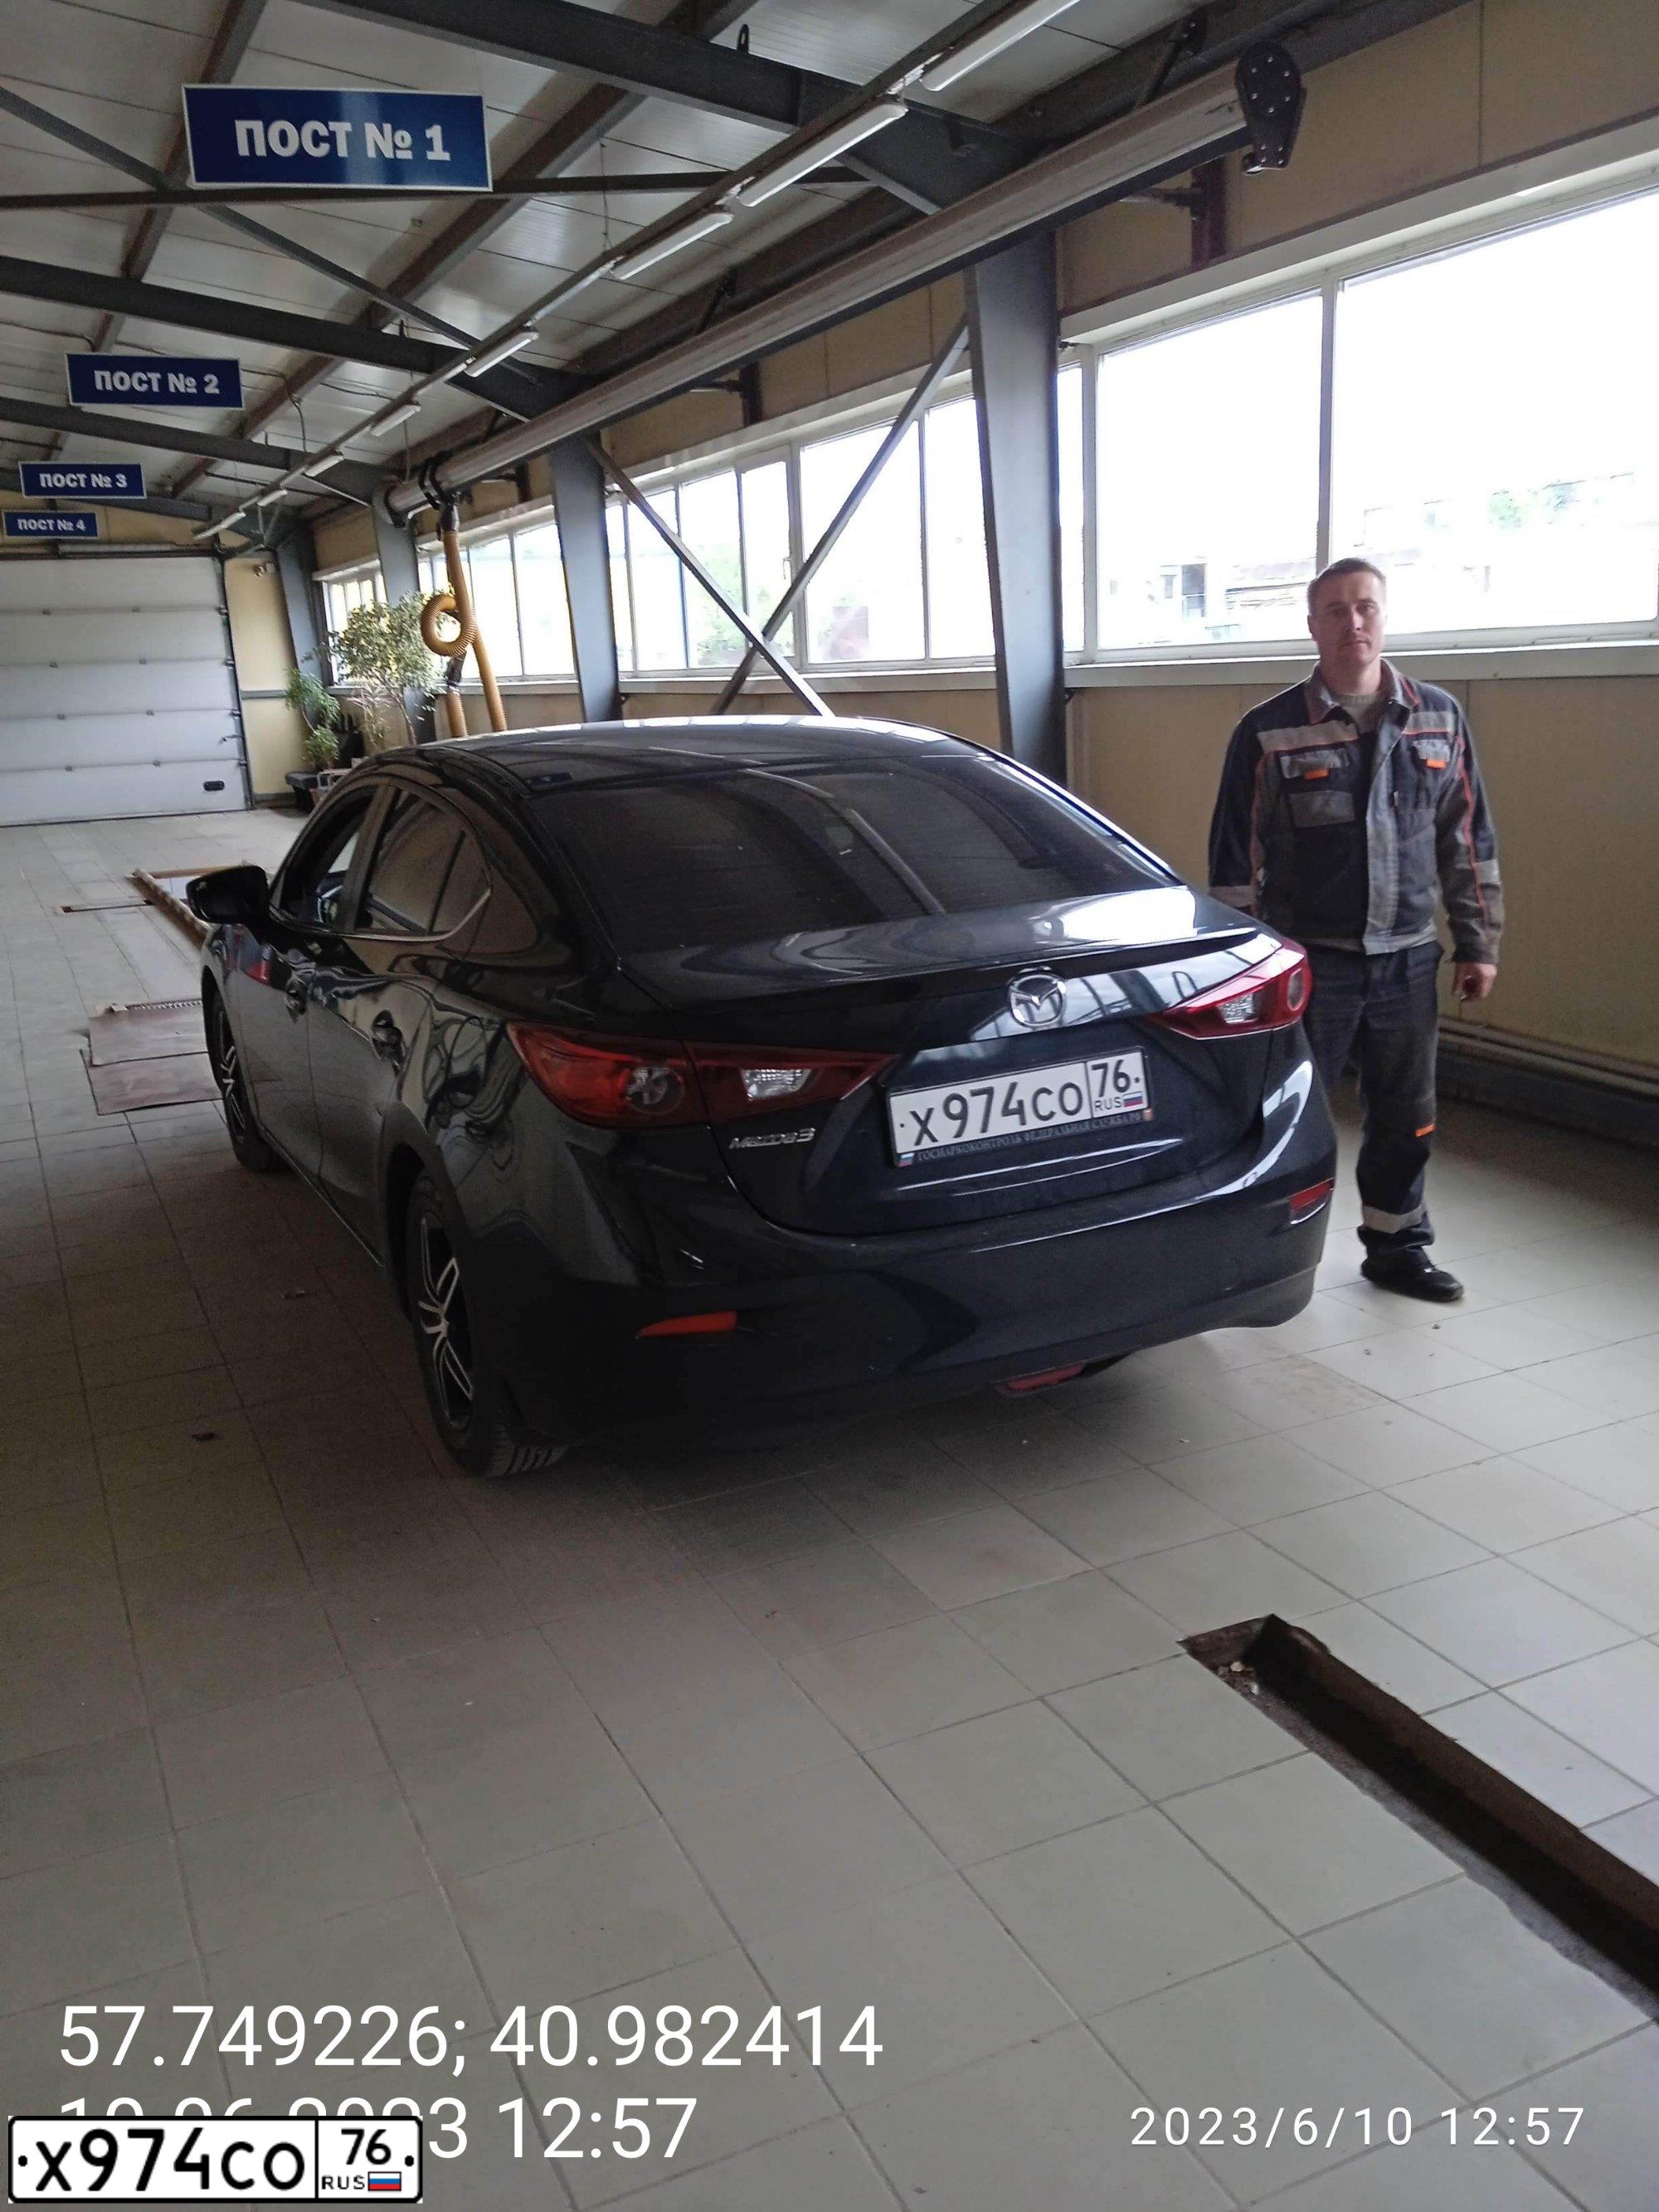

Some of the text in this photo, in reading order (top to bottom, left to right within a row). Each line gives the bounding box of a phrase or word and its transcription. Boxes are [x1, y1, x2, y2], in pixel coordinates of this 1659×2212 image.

[235, 120, 450, 161] ПОСТ № 1
[94, 370, 220, 394] ПОСТ № 2
[39, 473, 128, 488] ПОСТ № 3
[17, 518, 86, 532] ПОСТ № 4
[1092, 1059, 1131, 1098] 76
[1094, 1097, 1122, 1112] RUS
